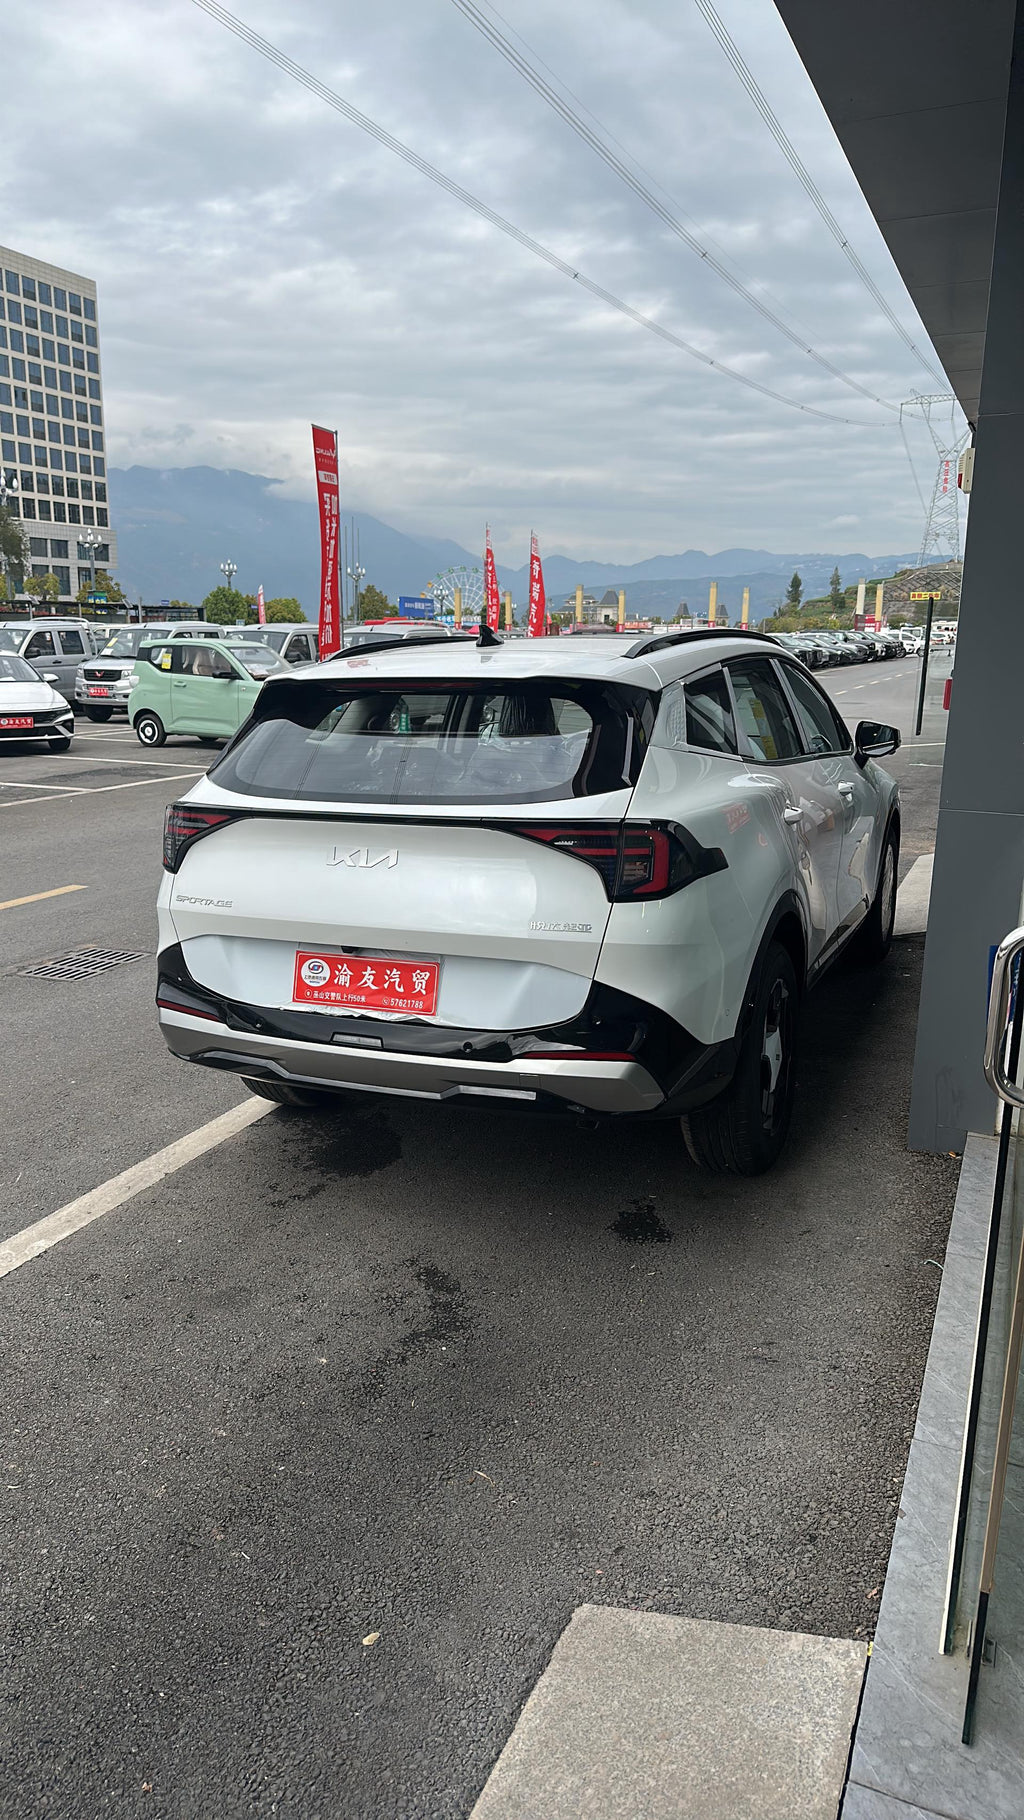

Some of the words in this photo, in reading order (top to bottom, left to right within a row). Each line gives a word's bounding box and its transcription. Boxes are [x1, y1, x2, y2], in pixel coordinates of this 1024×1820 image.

[326, 846, 399, 869] KIA
[176, 894, 233, 908] SPORTAGE
[333, 962, 431, 996] 渝友汽贸
[390, 998, 424, 1009] 57621788
